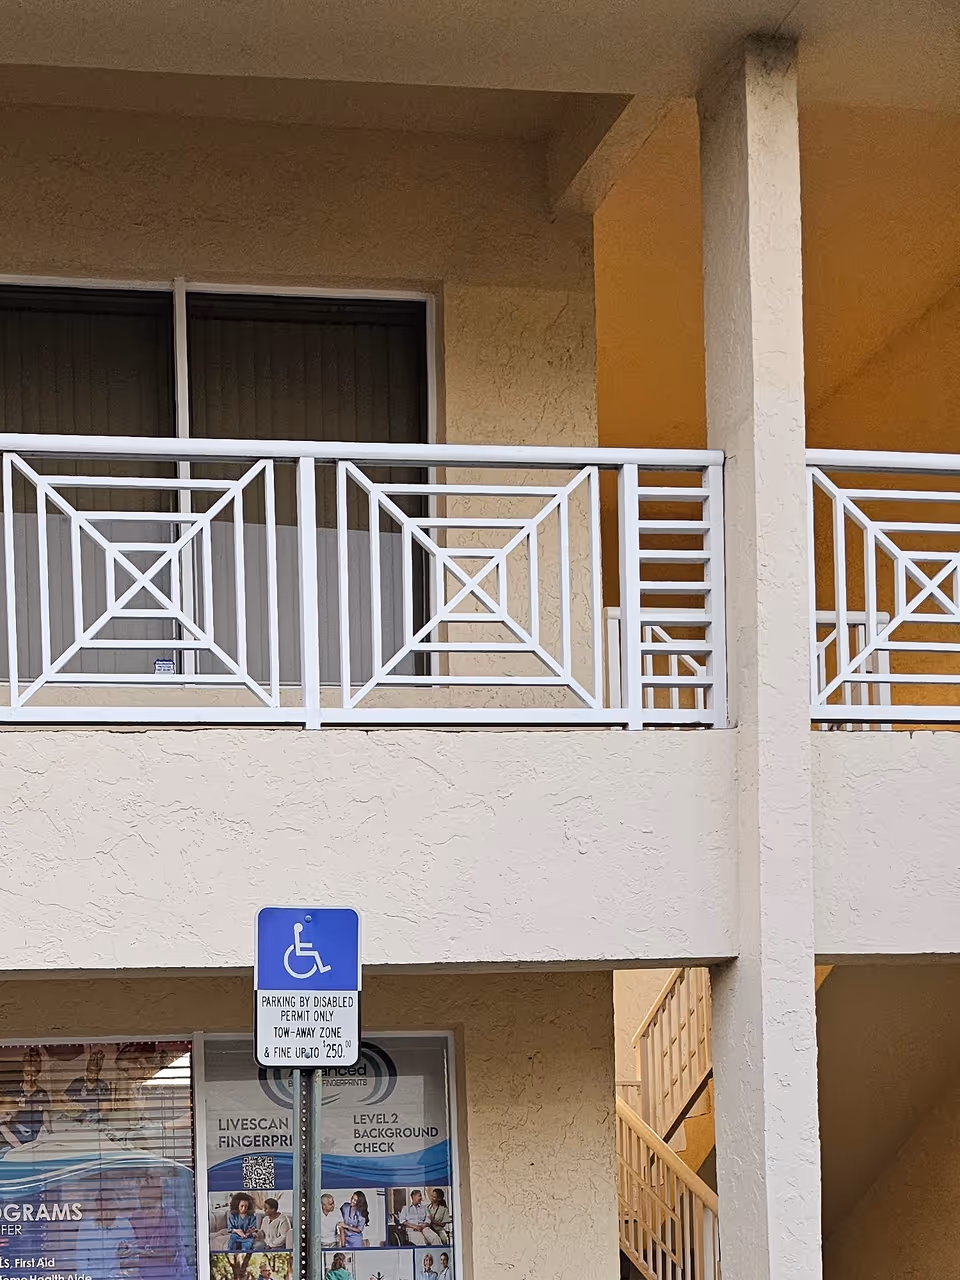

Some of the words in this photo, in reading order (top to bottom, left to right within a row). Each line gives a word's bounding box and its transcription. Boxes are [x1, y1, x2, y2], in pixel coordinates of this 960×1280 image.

[261, 996, 296, 1008] PARKING
[299, 996, 310, 1008] BY
[313, 995, 354, 1008] DISABLED
[280, 1010, 310, 1022] PERMIT
[313, 1010, 334, 1022] ONLY
[273, 1027, 316, 1038] TOW-AWAY
[319, 1027, 342, 1038] ZONE
[264, 1047, 270, 1058] &
[274, 1047, 292, 1059] FINE
[295, 1047, 307, 1059] UP
[310, 1047, 320, 1059] TO
[218, 1117, 289, 1131] LIVESCAN
[353, 1113, 389, 1125] LEVEL
[391, 1112, 399, 1124] 2
[353, 1127, 439, 1139] BACKGROUND
[353, 1142, 395, 1153] CHECK
[14, 1258, 37, 1268] First
[36, 1257, 55, 1268] Aid
